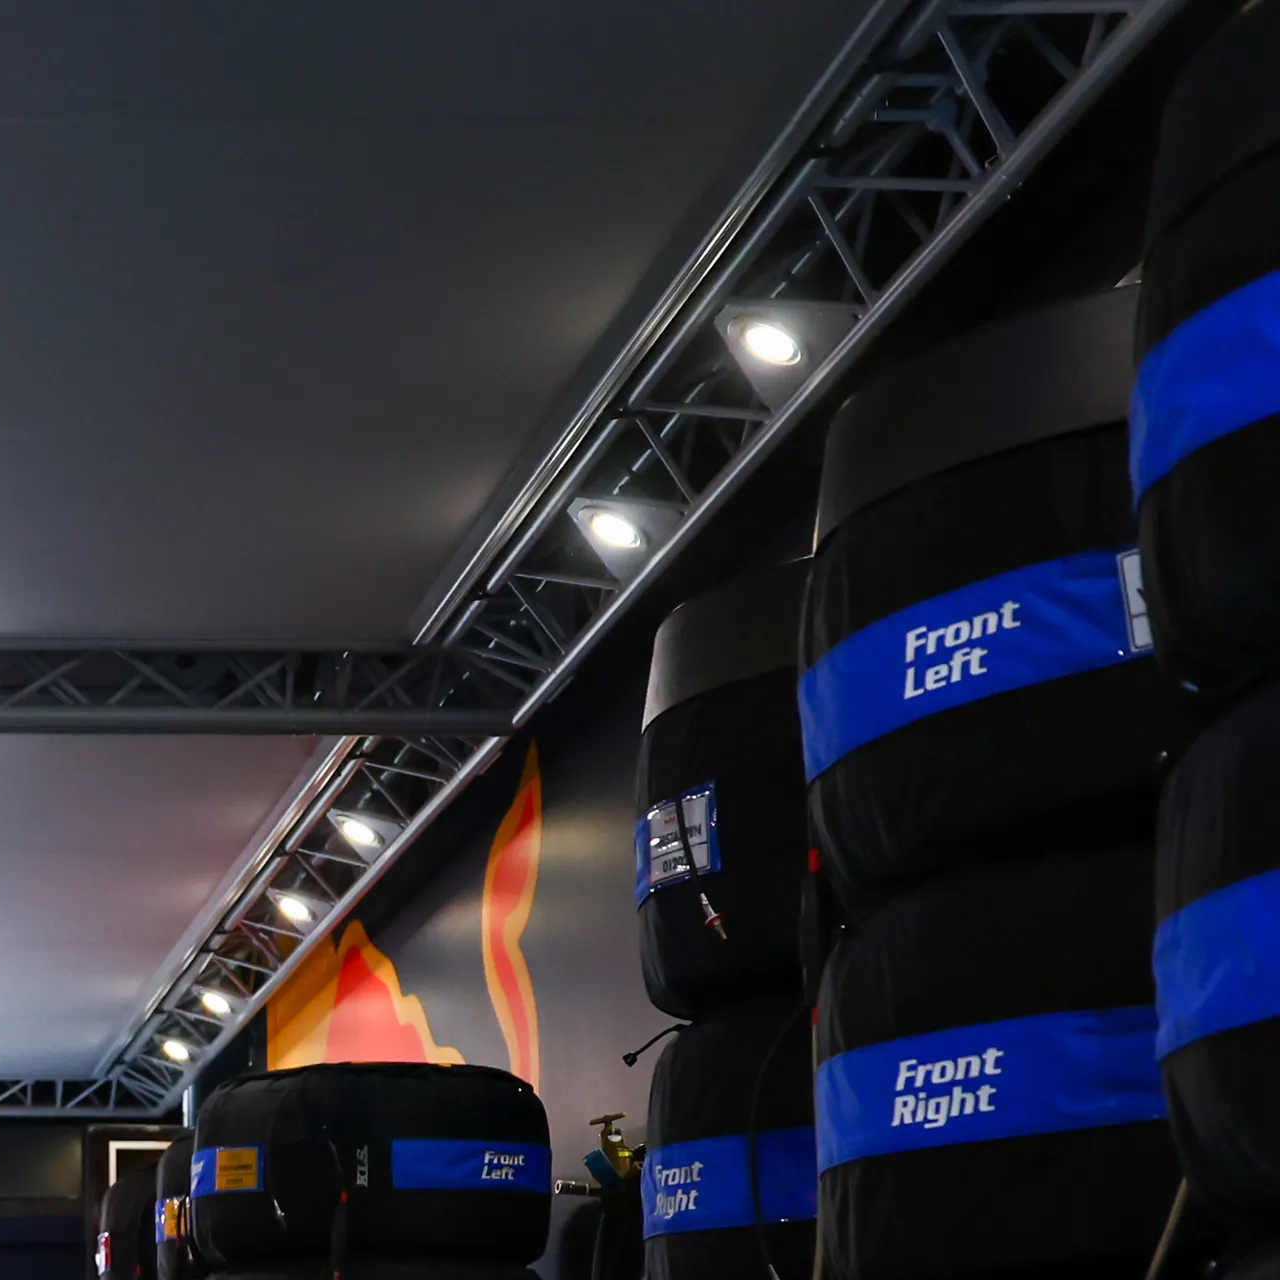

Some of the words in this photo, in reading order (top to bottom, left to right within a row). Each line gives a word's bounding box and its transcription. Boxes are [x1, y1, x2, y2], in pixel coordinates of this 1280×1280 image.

[905, 600, 1022, 664] Front
[903, 646, 988, 700] Left
[894, 1046, 1005, 1092] Front
[890, 1084, 998, 1130] Right
[481, 1165, 517, 1181] Left
[483, 1150, 526, 1167] Front
[654, 1161, 705, 1190] Front
[653, 1188, 700, 1220] Right
